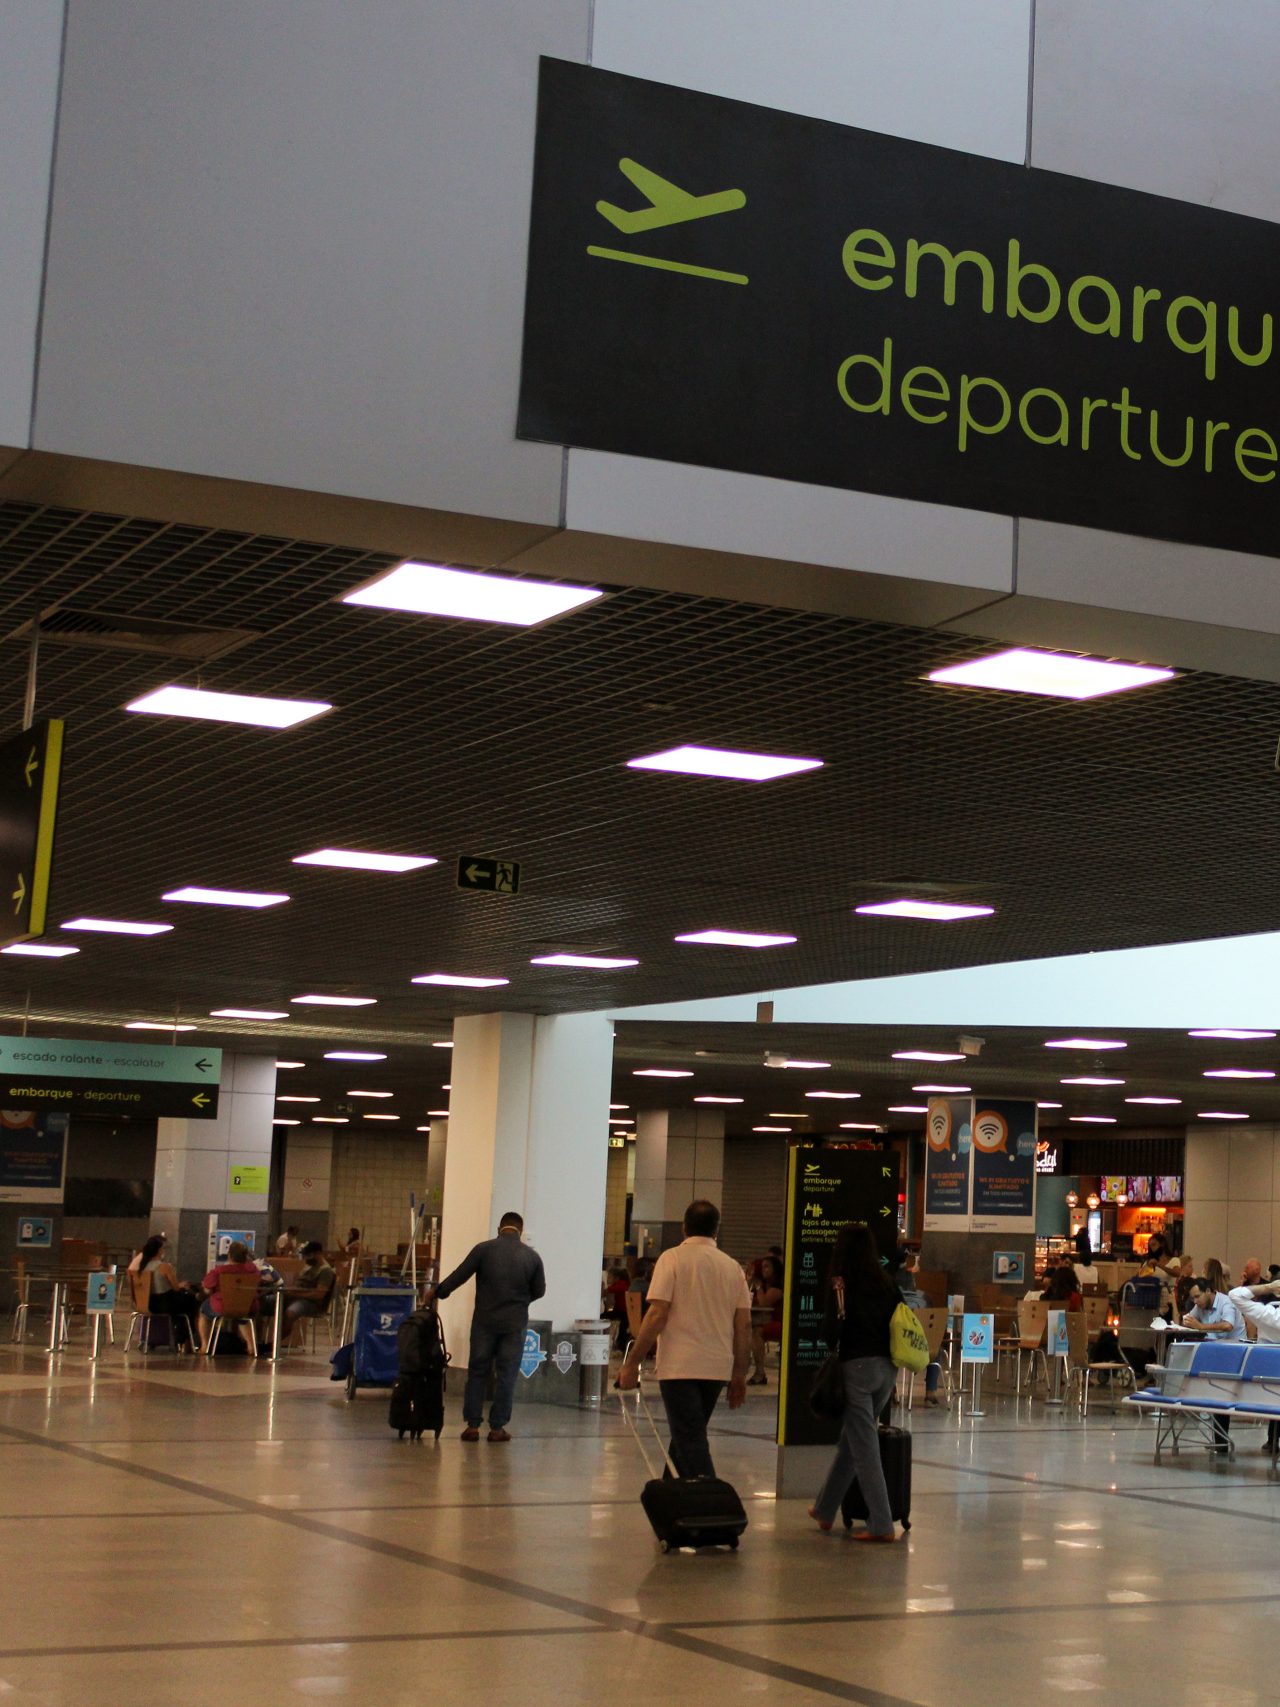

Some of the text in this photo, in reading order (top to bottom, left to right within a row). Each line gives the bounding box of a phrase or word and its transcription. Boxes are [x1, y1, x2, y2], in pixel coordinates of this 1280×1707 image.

[837, 338, 1278, 483] departure
[13, 1051, 57, 1063] escada
[60, 1053, 103, 1065] rolante
[113, 1056, 166, 1069] escalator
[9, 1086, 73, 1100] embarque
[84, 1089, 141, 1102] departure
[803, 1177, 842, 1186] embarque
[802, 1218, 819, 1228] lojas
